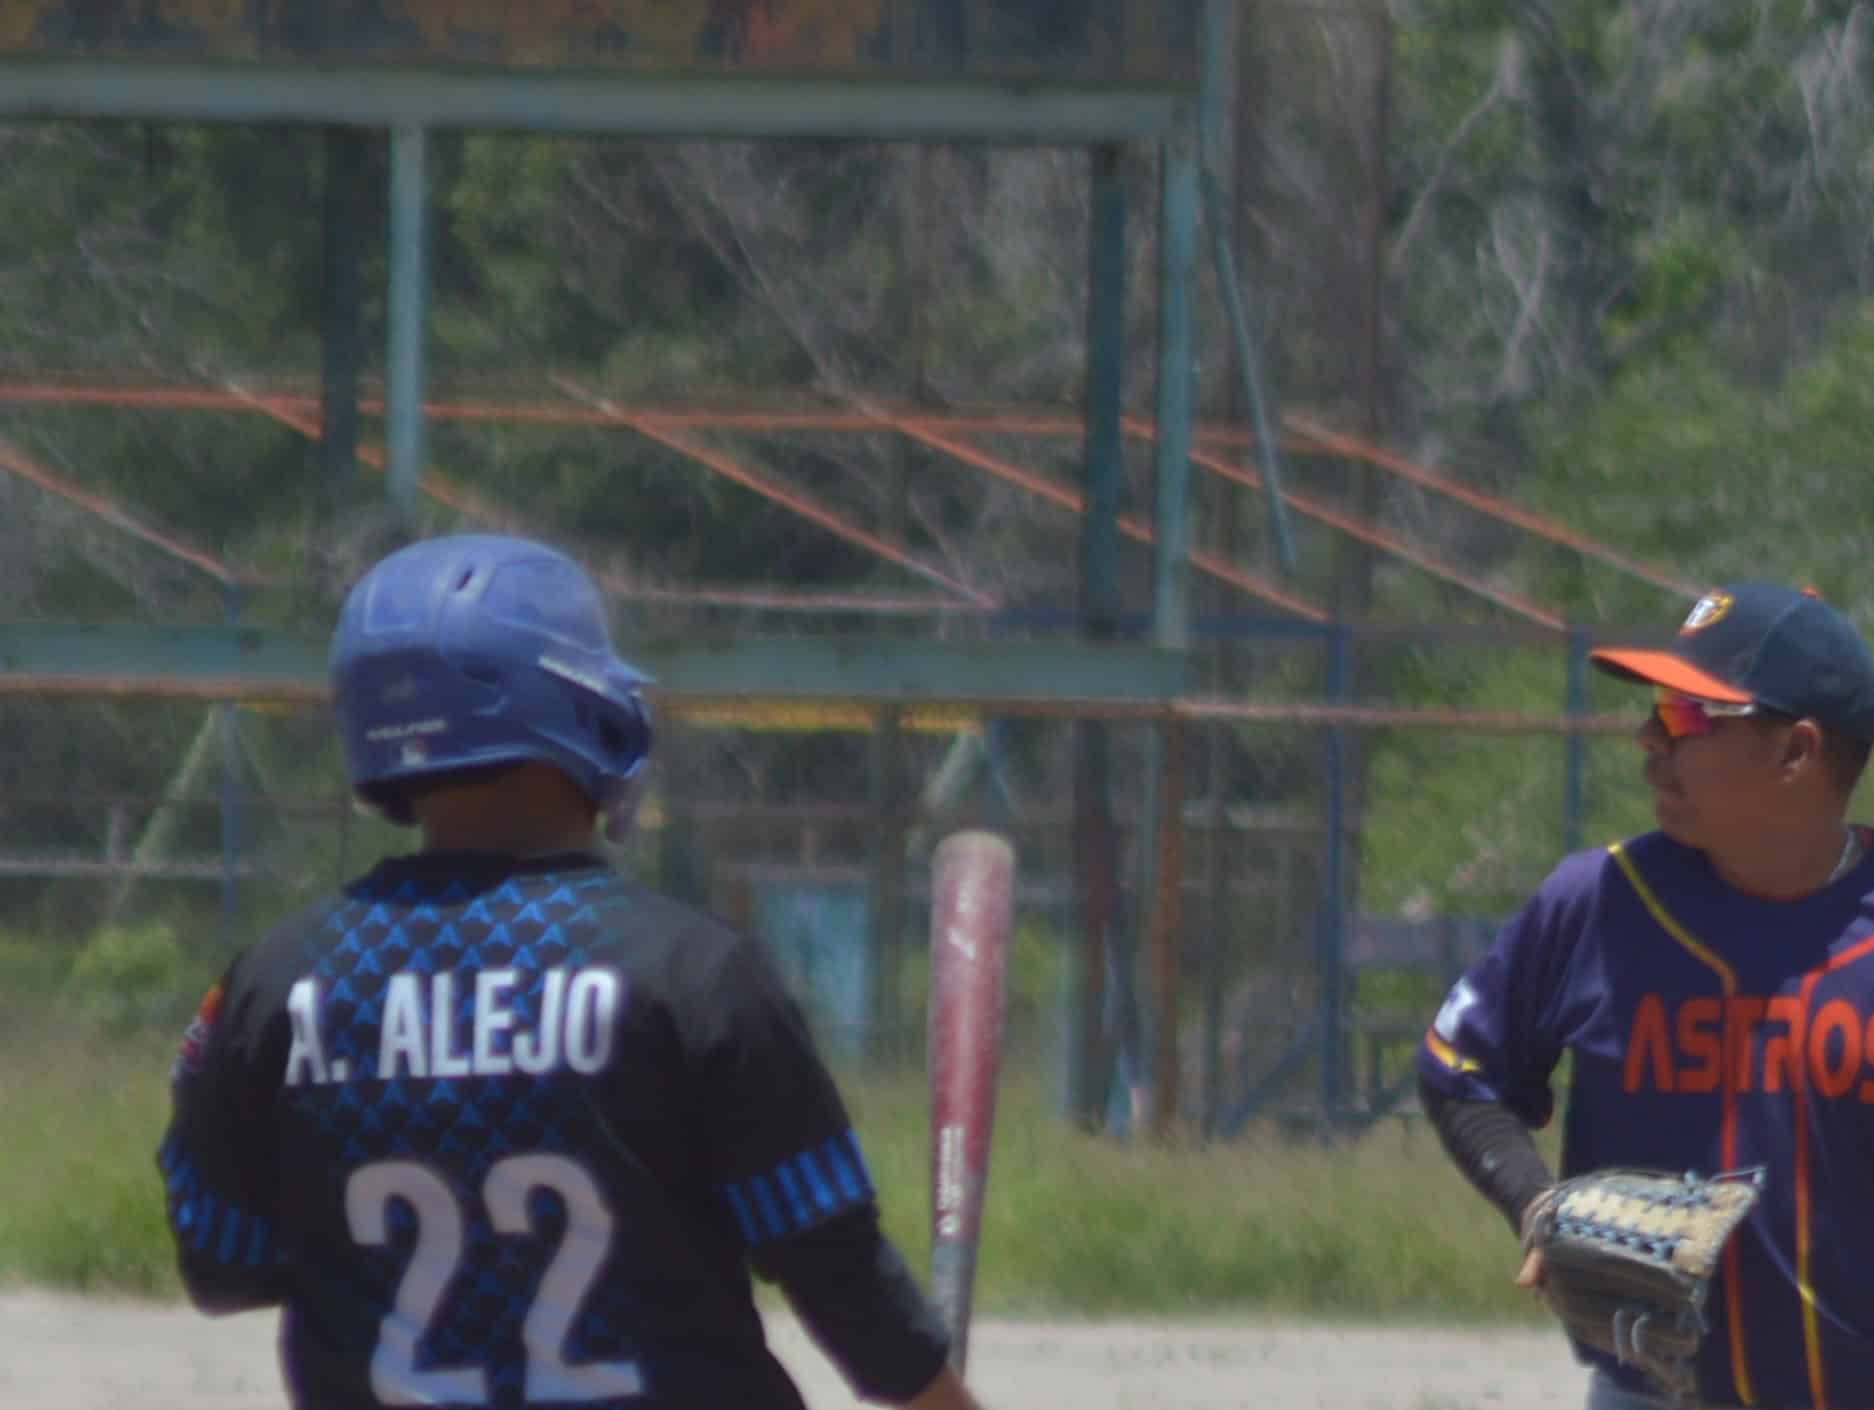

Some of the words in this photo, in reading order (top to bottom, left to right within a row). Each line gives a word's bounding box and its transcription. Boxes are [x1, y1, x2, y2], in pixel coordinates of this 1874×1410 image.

[286, 976, 350, 1085] A.
[379, 968, 617, 1079] ALEJO
[345, 1155, 644, 1406] 22
